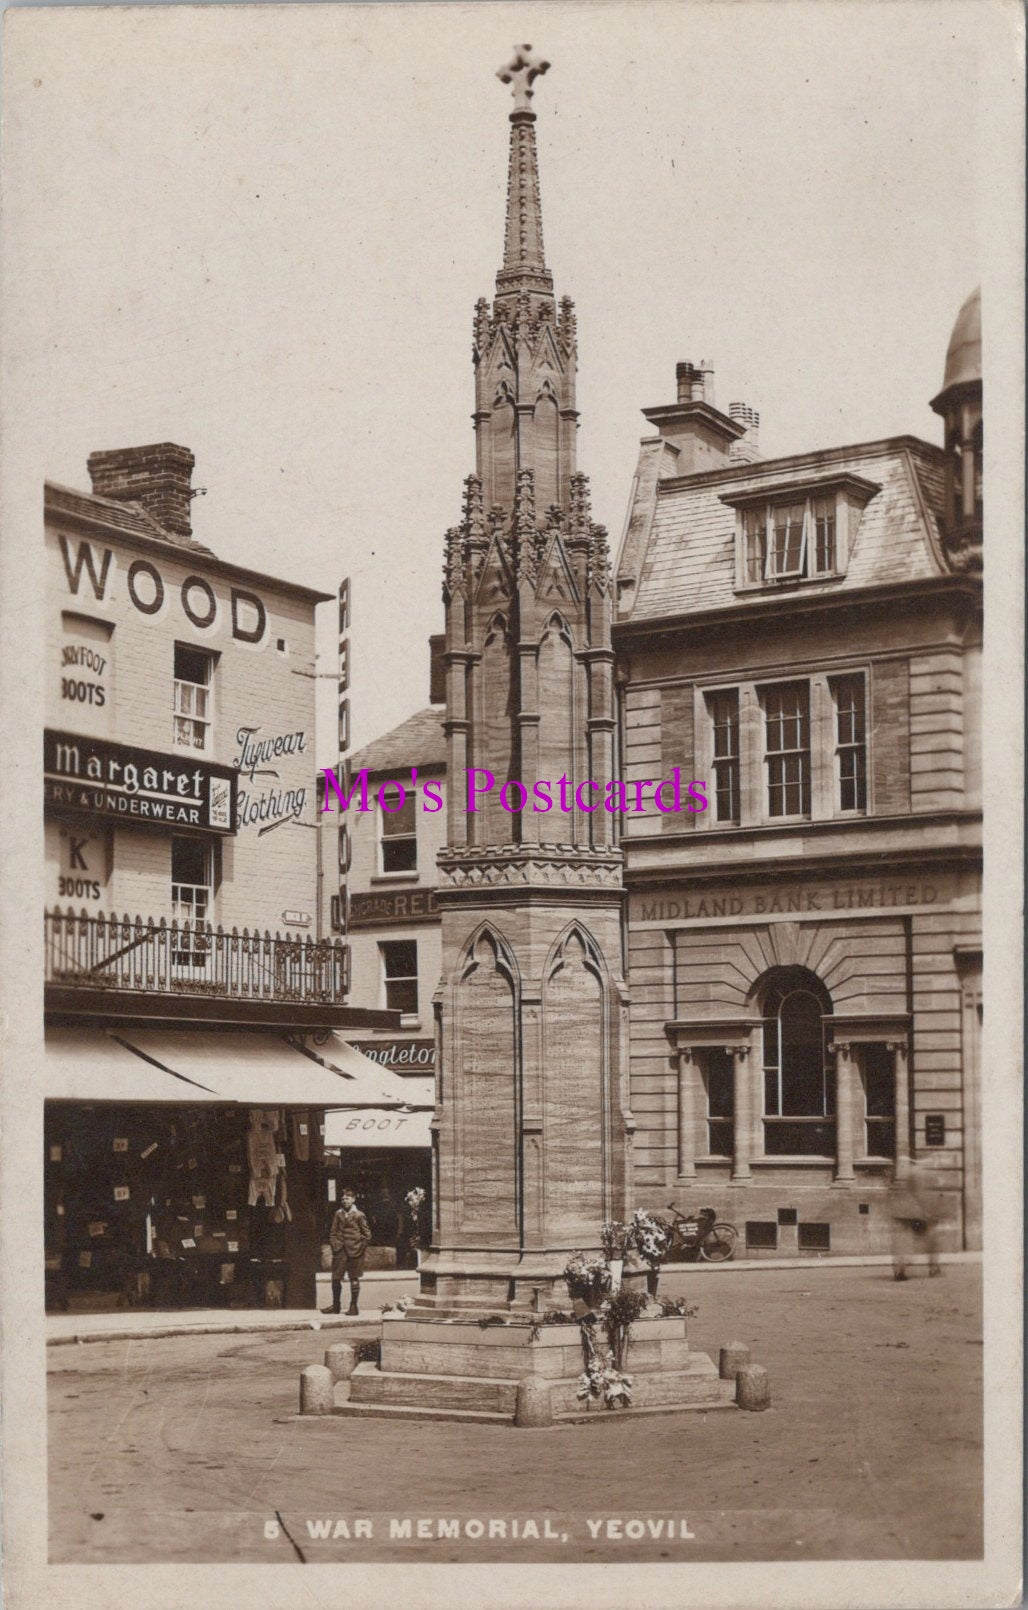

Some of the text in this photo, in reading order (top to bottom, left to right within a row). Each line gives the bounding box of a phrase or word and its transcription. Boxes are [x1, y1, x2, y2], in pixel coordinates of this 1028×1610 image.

[79, 792, 90, 806] &
[94, 792, 200, 824] UNDERWEAR
[640, 884, 938, 921] MIDLAND BANK LIMITED
[345, 1118, 408, 1131] BOOT
